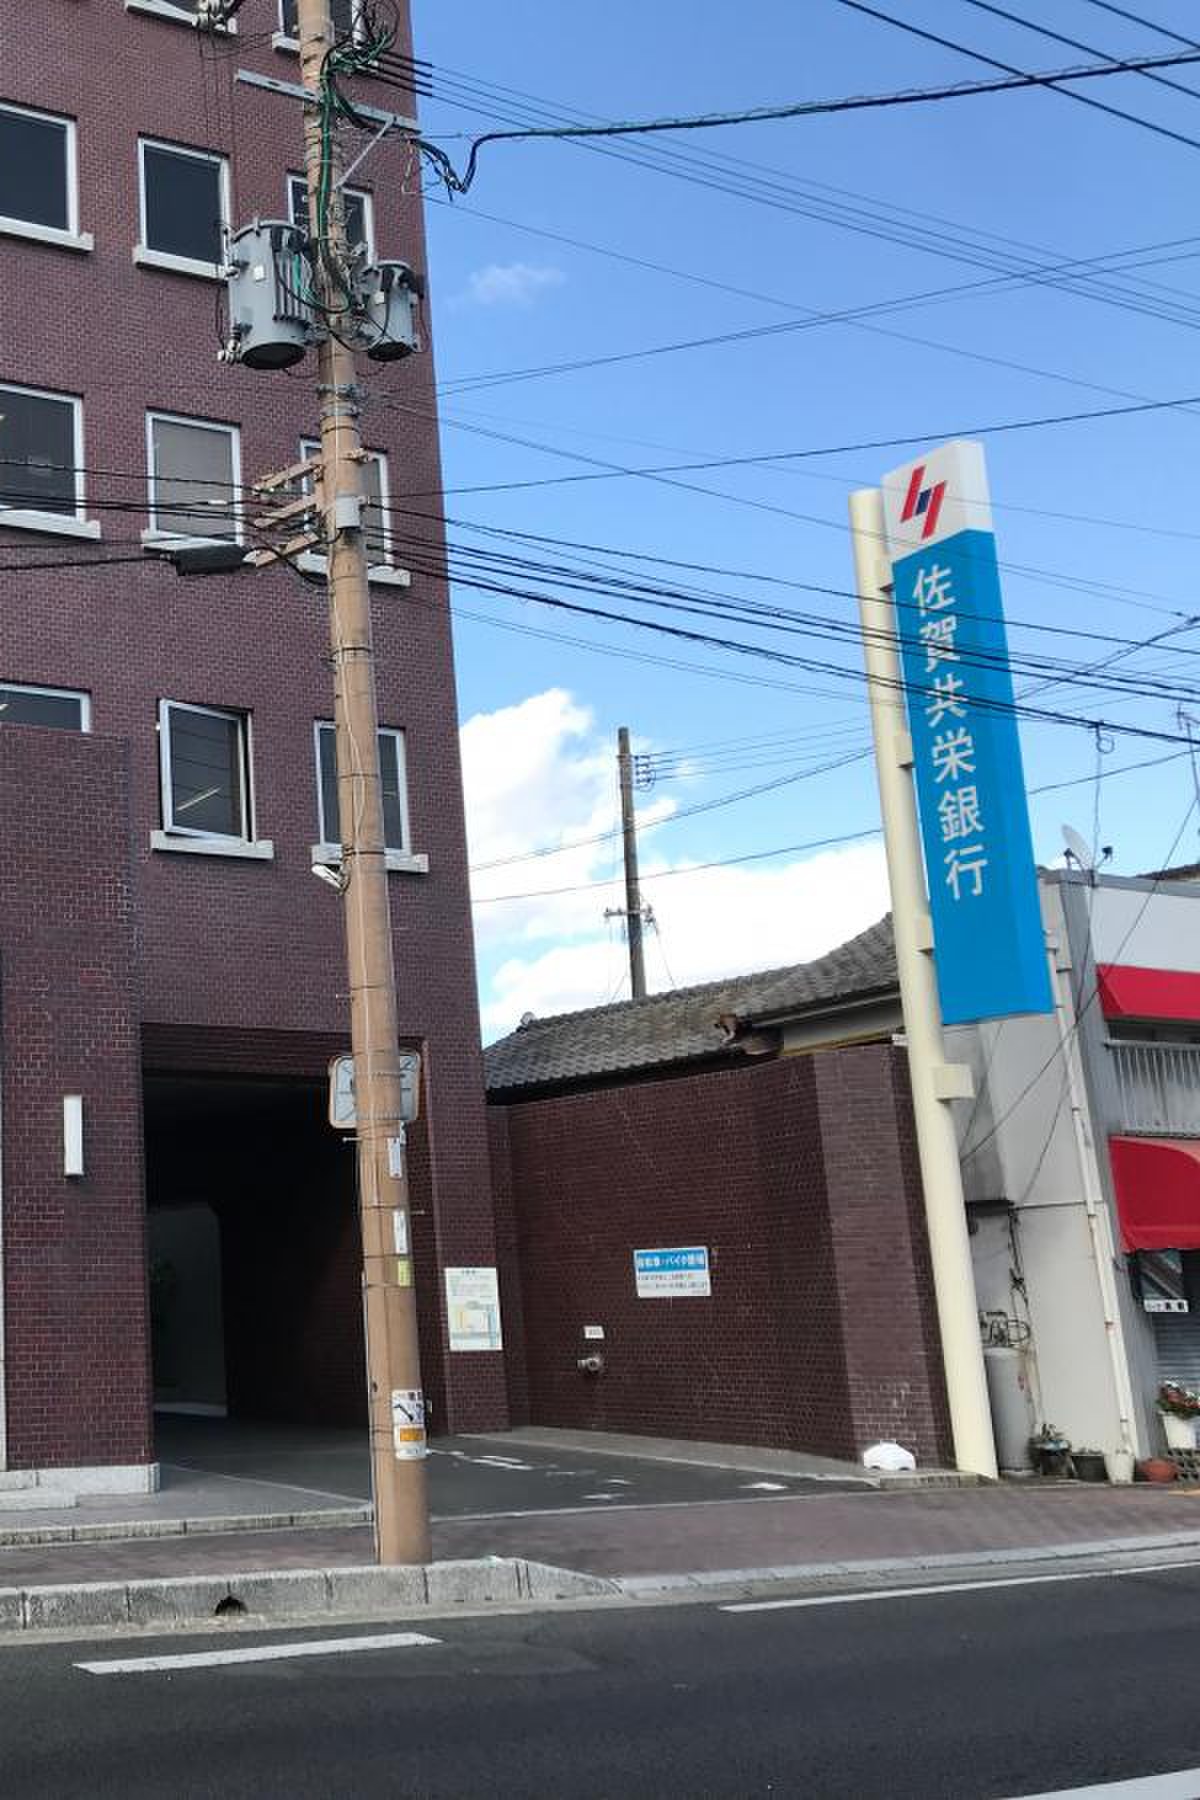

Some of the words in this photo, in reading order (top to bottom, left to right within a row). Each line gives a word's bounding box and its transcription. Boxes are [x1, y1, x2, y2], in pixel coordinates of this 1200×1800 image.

[912, 562, 988, 899] 佐賀共栄銀行
